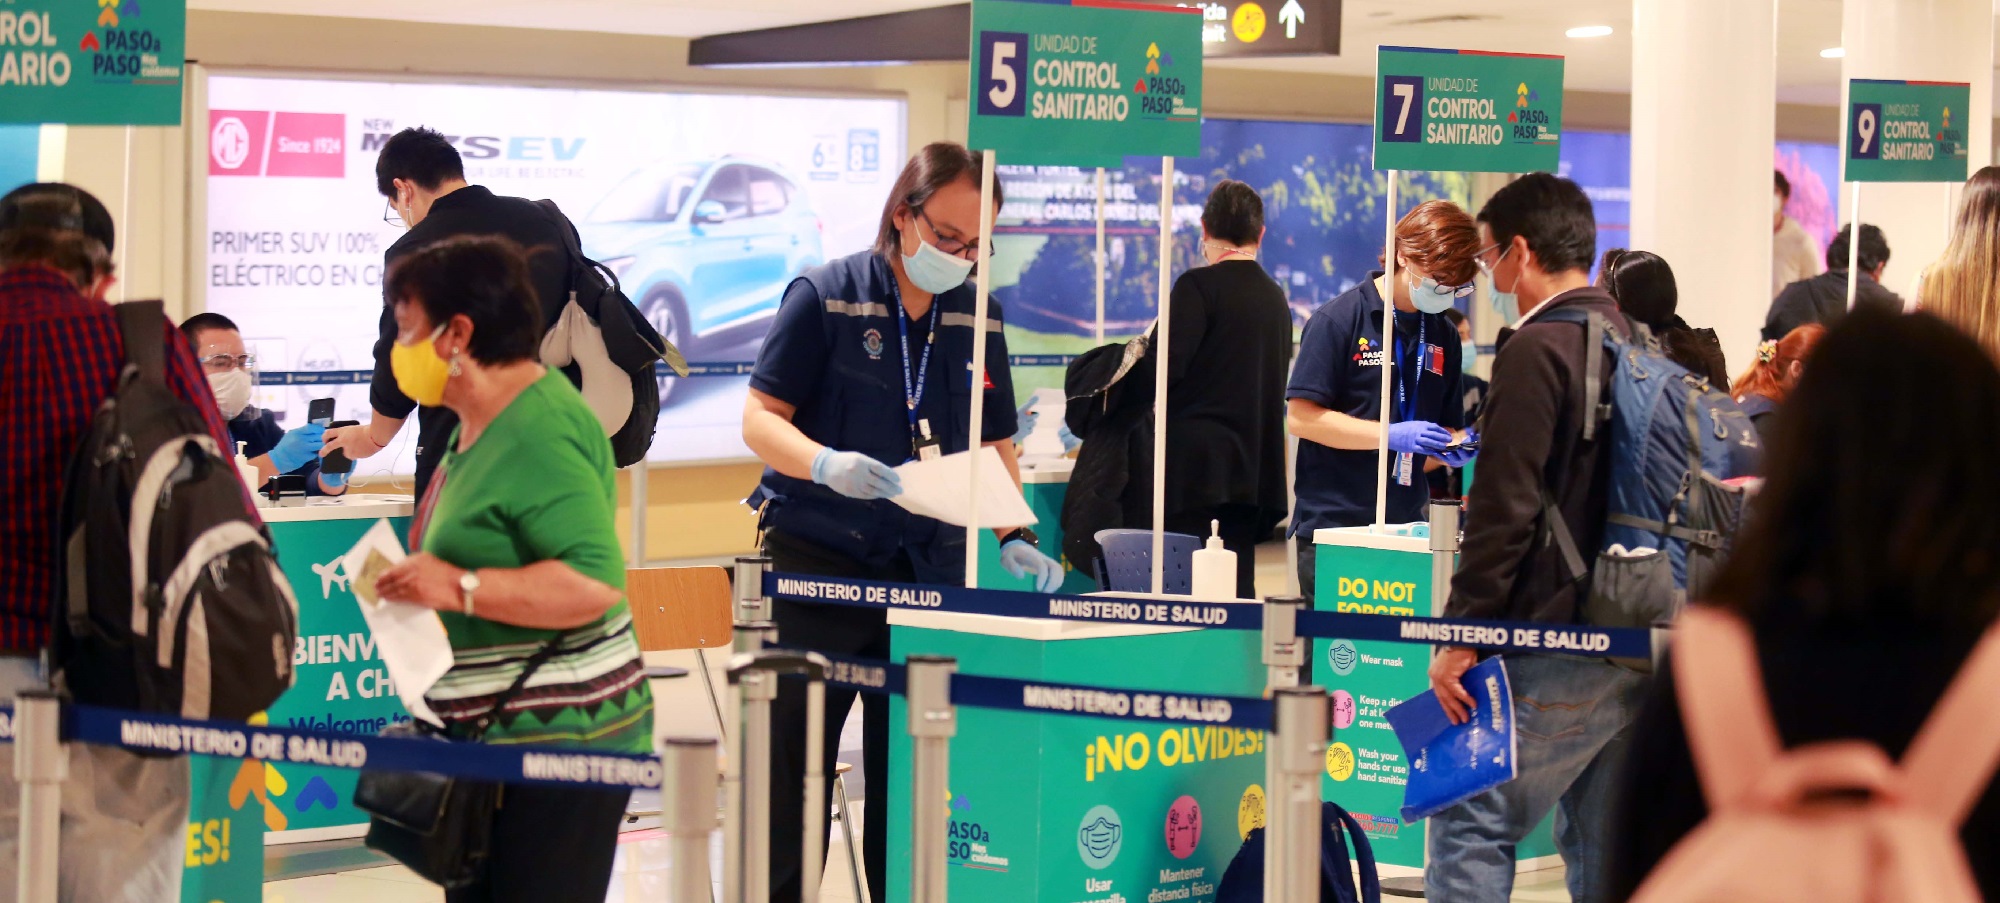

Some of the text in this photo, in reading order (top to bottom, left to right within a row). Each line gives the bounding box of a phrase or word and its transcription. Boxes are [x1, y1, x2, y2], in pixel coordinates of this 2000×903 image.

[1034, 34, 1098, 54] UNIDAD DE
[94, 54, 141, 76] PASO
[988, 42, 1016, 108] 5
[1033, 59, 1121, 89] CONTROL
[1428, 78, 1478, 92] UNIDAD DE
[1032, 92, 1129, 122] SANITARIO
[1142, 96, 1172, 114] PASO
[1394, 84, 1414, 134] 7
[1427, 97, 1496, 120] CONTROL
[363, 118, 394, 130] NEW
[1426, 123, 1504, 145] SANITARIO
[1514, 125, 1538, 138] PASO
[1858, 109, 1876, 154] 9
[1884, 121, 1930, 138] CONTROL
[278, 136, 340, 154] Since 1924
[1882, 142, 1934, 160] SANITARIO
[212, 232, 379, 254] PRIMER SUV 100%
[212, 258, 325, 286] ELÉCTRICO
[331, 264, 357, 286] EN
[919, 357, 928, 376] SALUD
[778, 578, 942, 608] MINISTERIO DE SALUD
[1338, 576, 1416, 602] DO NOT
[1049, 598, 1228, 624] MINISTERIO DE SALUD
[1400, 621, 1610, 652] MINISTERIO DE SALUD
[293, 632, 383, 666] BIENV
[1360, 654, 1404, 666] Wear mask
[326, 668, 398, 702] A CH
[834, 662, 849, 682] DE
[850, 664, 886, 688] SALUD
[1023, 685, 1232, 722] MINISTERIO DE SALUD
[1360, 695, 1380, 707] Keep
[1370, 709, 1378, 717] at
[1359, 720, 1394, 730] one met
[121, 720, 367, 768] MINISTERIO DE SALUD
[1086, 725, 1263, 782] ¡NO OLVIDES!
[1358, 748, 1398, 762] Wash your
[522, 752, 664, 788] MINISTERIO
[1358, 760, 1380, 770] hands
[1392, 765, 1406, 774] use
[1358, 771, 1376, 782] hand
[949, 841, 970, 860] SO
[1086, 878, 1112, 893] Usar
[1160, 866, 1204, 884] Mantener
[1148, 886, 1190, 903] distancia
